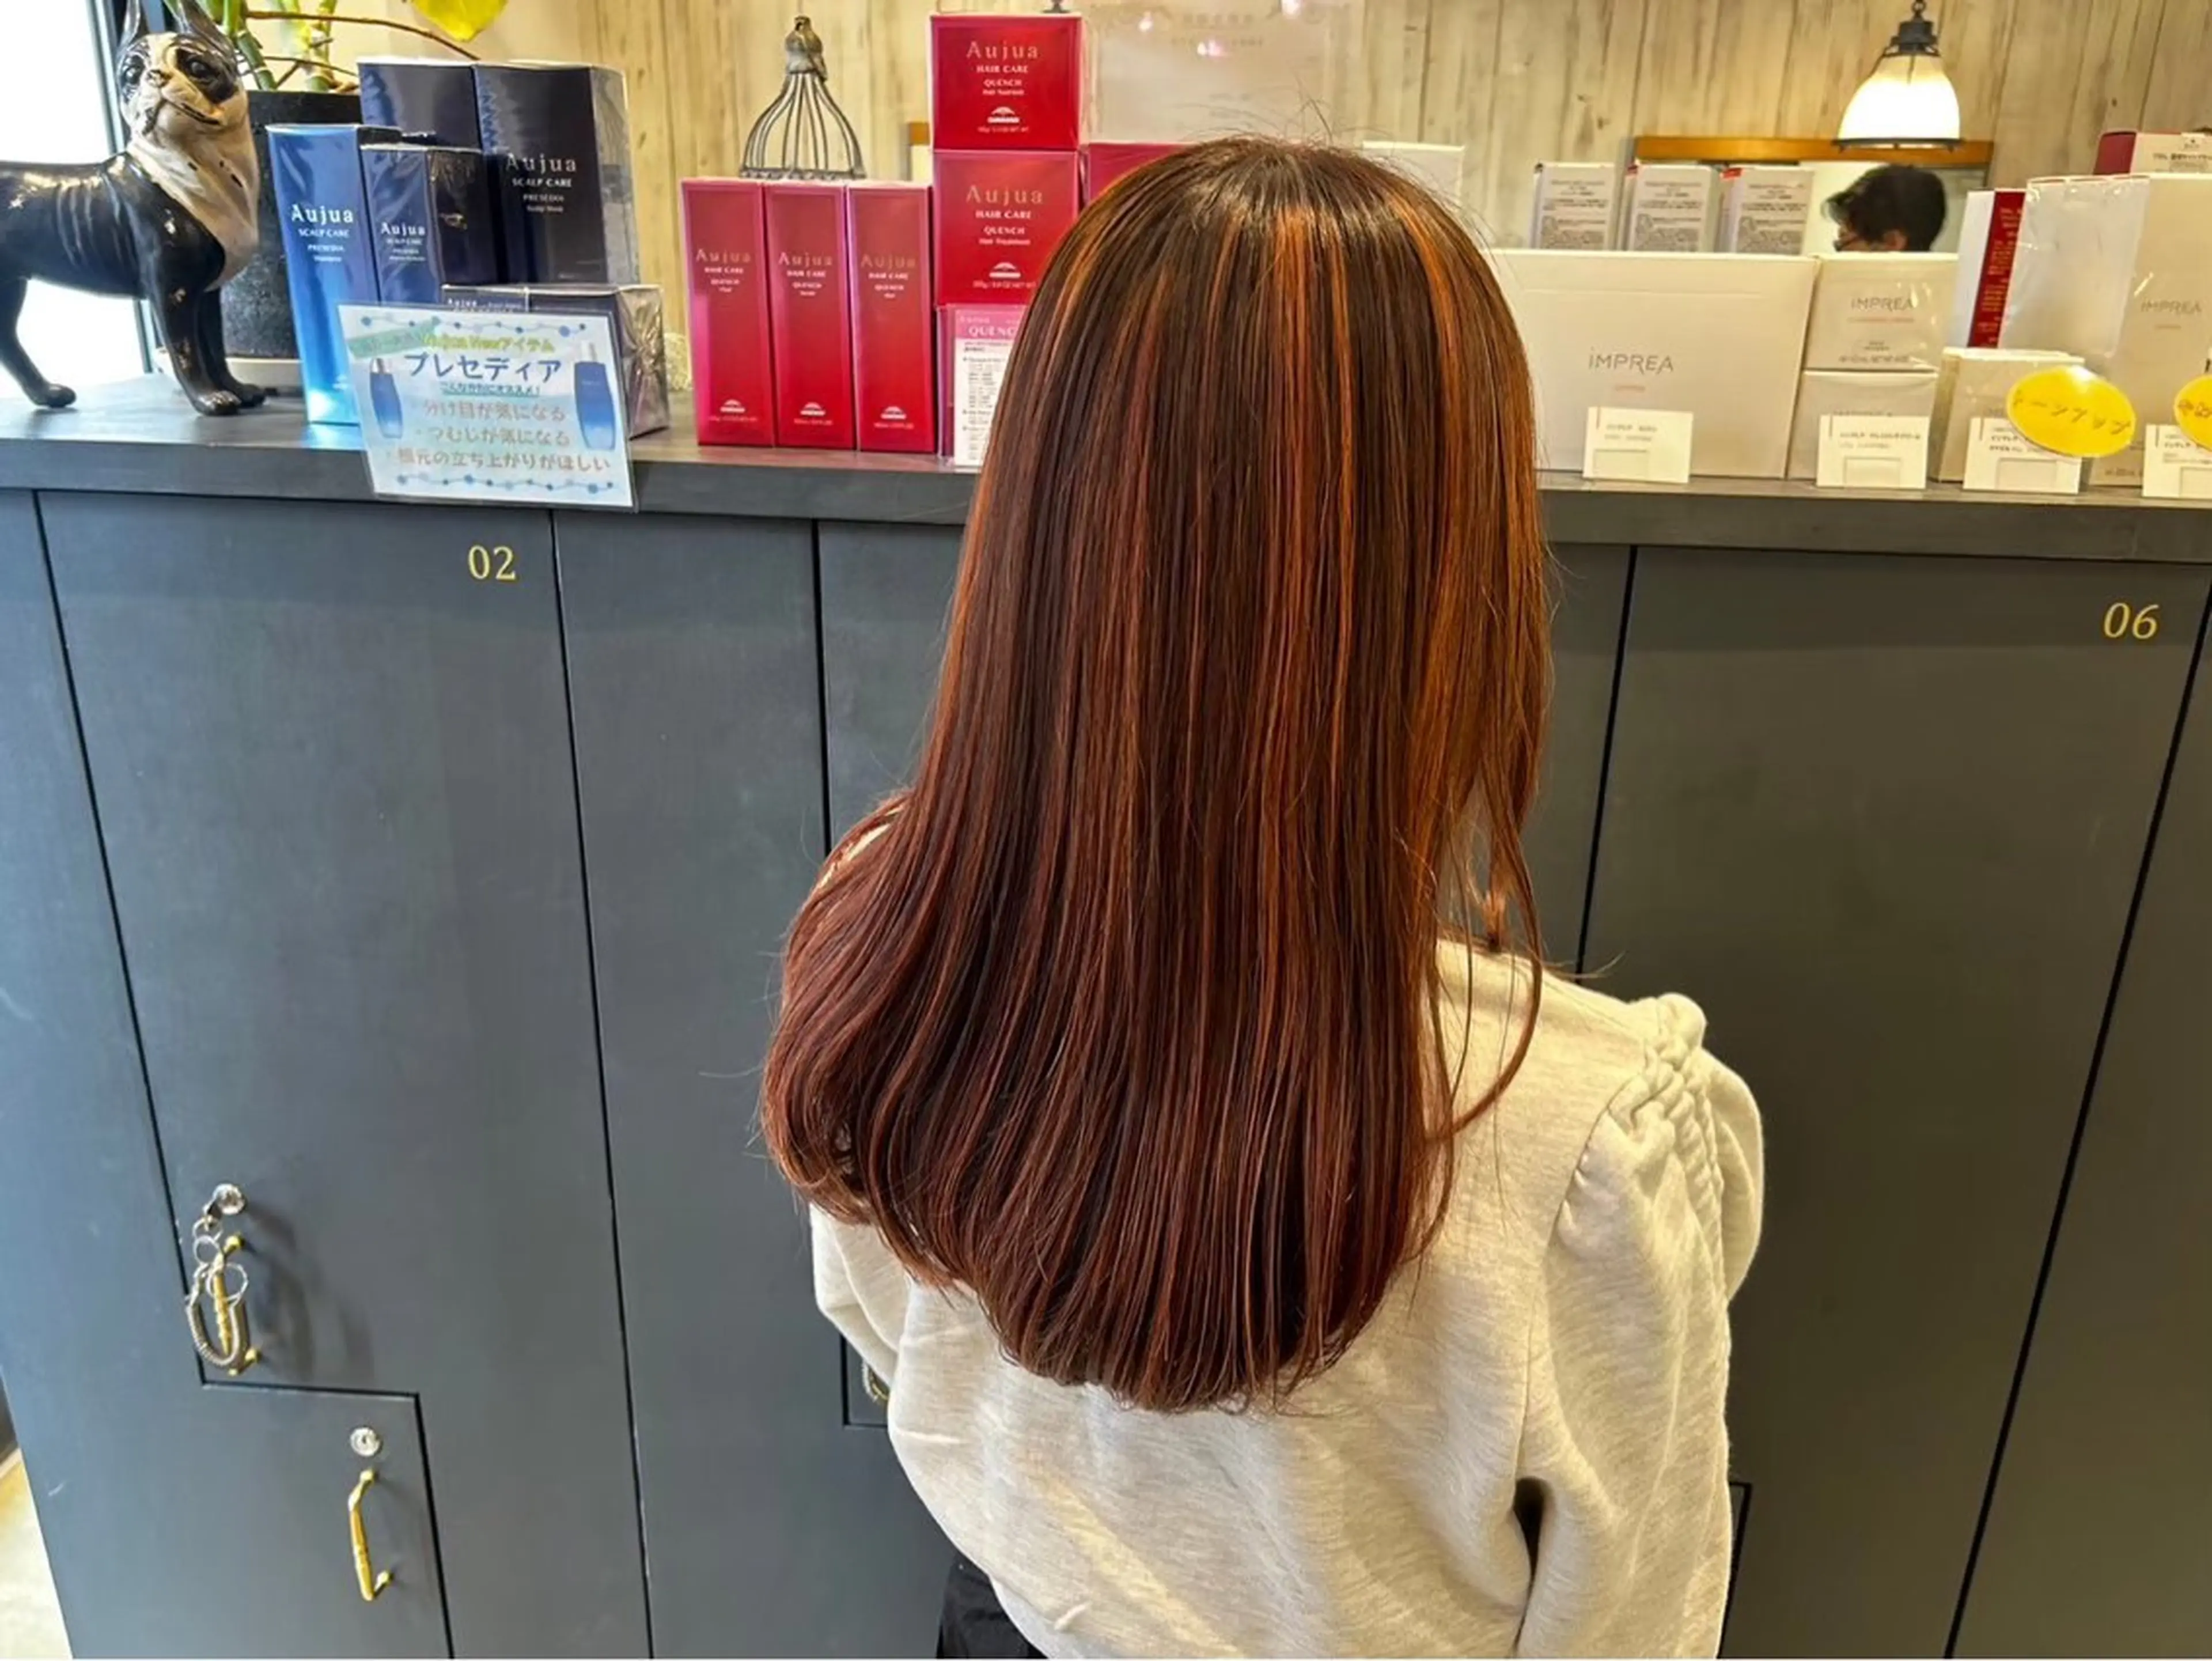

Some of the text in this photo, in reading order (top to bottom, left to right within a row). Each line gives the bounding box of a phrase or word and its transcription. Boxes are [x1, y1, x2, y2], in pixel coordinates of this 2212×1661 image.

[966, 40, 1037, 60] Aujua
[506, 153, 575, 174] Aujua
[512, 178, 572, 187] SCALP CARE
[966, 185, 1042, 206] Aujua
[291, 203, 353, 226] Aujua
[975, 210, 1031, 219] HAIR CARE
[381, 222, 426, 237] Aujua
[696, 248, 751, 264] Aujua
[778, 252, 832, 268] Aujua
[861, 253, 915, 271] Aujua
[968, 325, 1017, 338] QUENC
[468, 544, 516, 580] 02
[2104, 603, 2160, 640] 06
